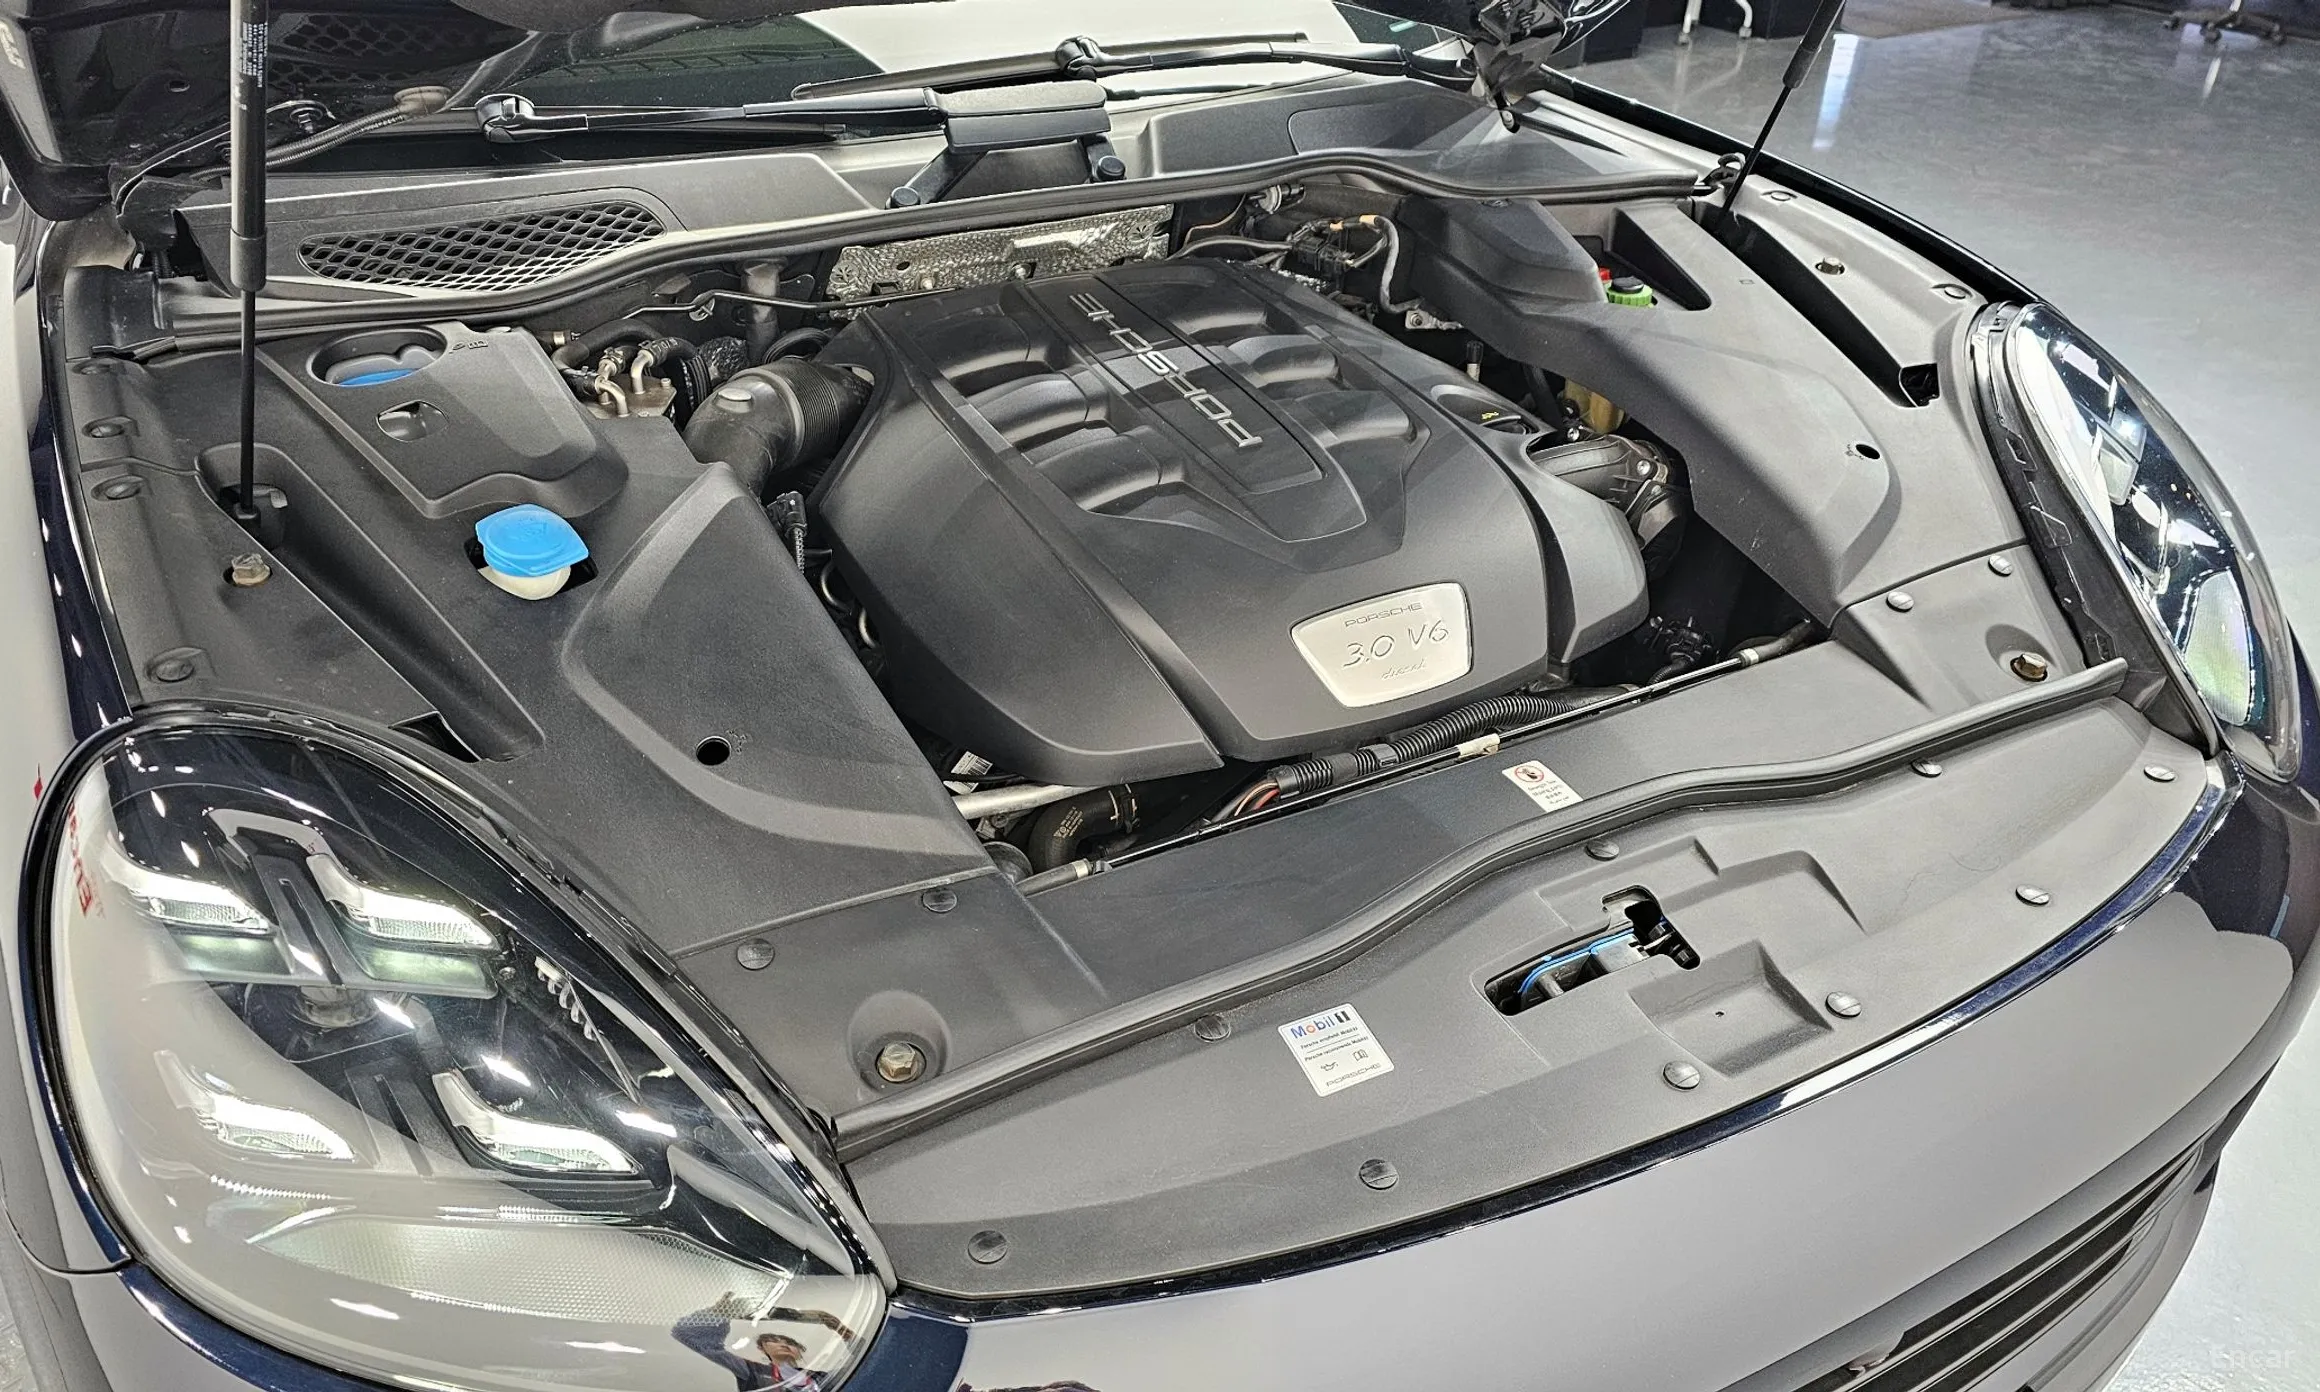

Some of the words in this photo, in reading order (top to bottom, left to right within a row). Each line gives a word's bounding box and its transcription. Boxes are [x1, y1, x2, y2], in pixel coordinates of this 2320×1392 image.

[1068, 292, 1263, 448] PORSCHE
[1345, 602, 1422, 627] PORSCHE
[1343, 635, 1395, 667] 3.0
[1407, 619, 1449, 647] V6
[1290, 1015, 1335, 1039] Mobil
[1326, 1063, 1381, 1087] PORSCHE
